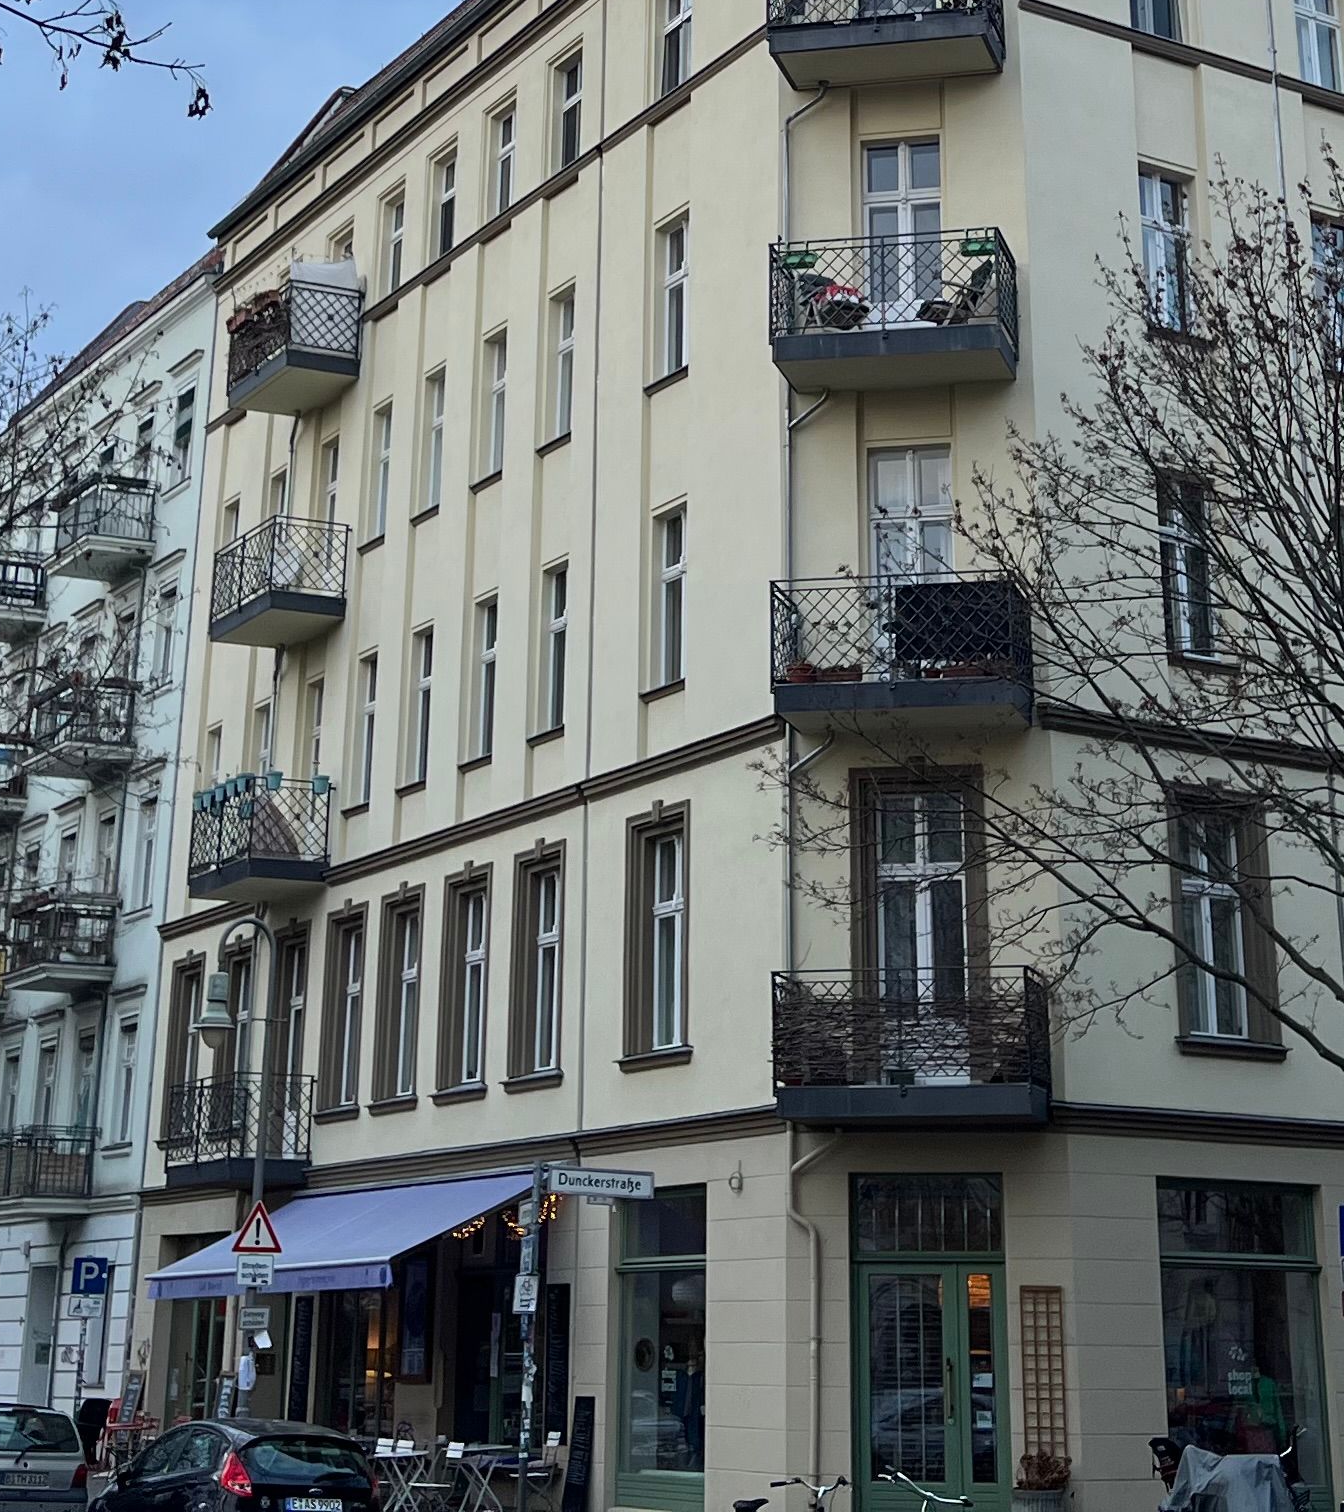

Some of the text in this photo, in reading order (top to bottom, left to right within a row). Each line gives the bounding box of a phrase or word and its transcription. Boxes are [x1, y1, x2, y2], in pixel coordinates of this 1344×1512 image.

[558, 1172, 641, 1193] Dunckerstraße
[79, 1261, 99, 1290] P
[1228, 1369, 1251, 1384] shop
[1228, 1382, 1252, 1395] local
